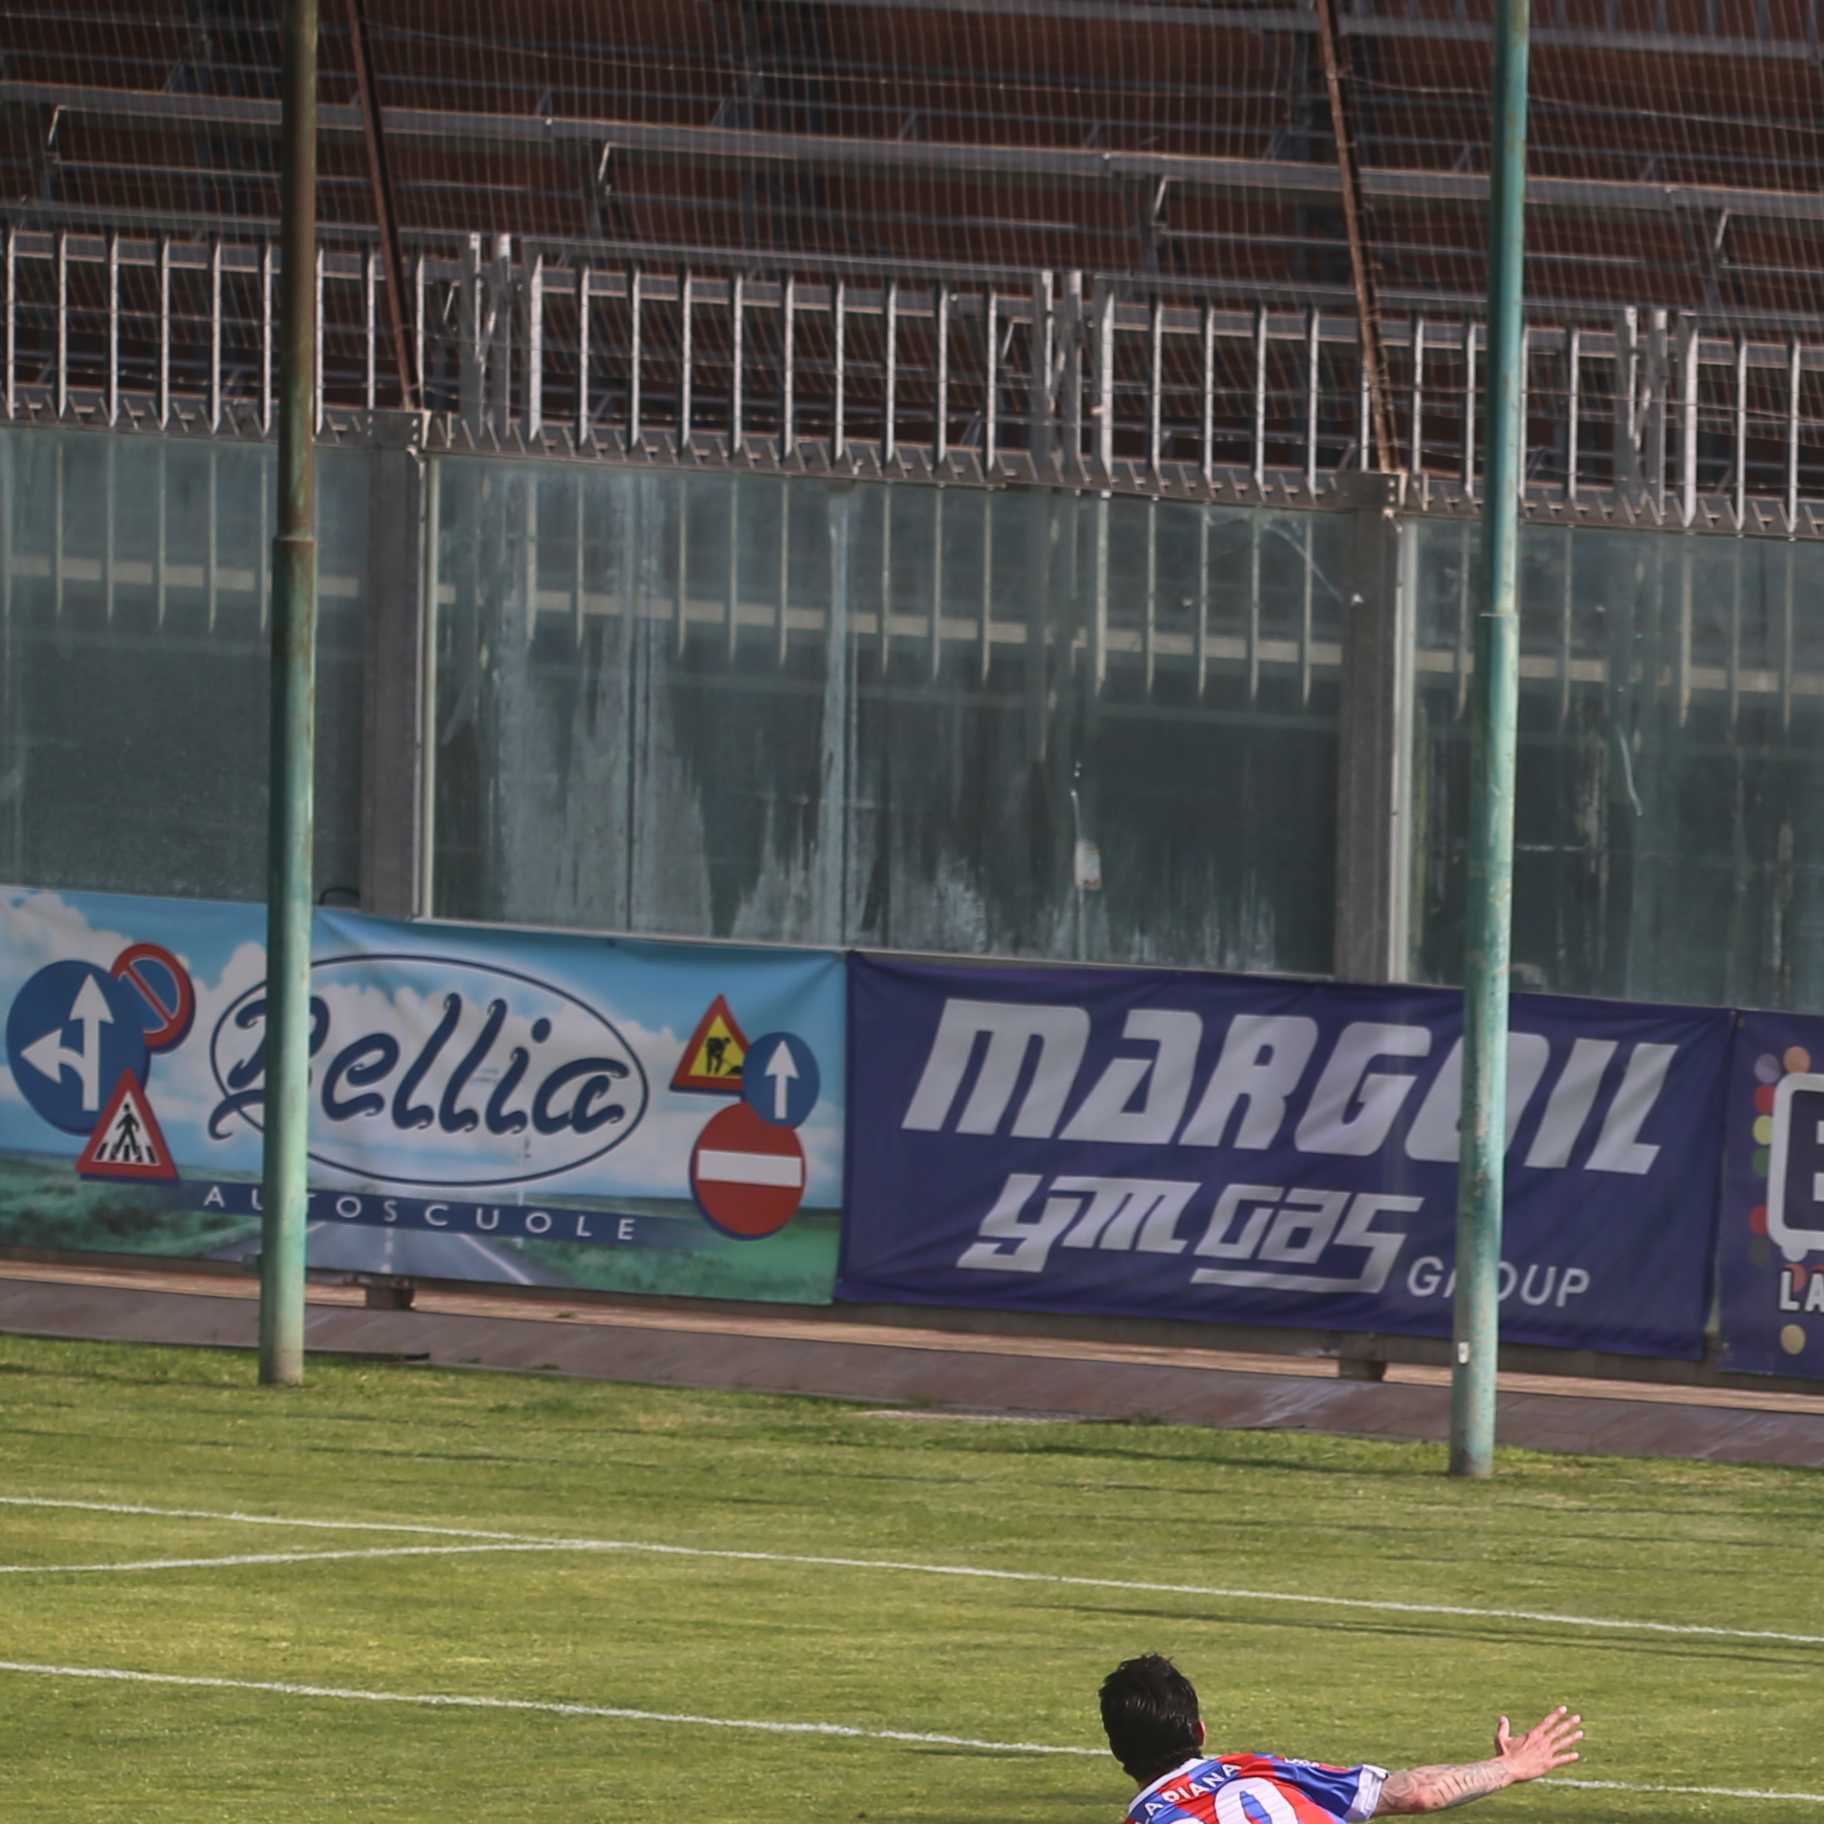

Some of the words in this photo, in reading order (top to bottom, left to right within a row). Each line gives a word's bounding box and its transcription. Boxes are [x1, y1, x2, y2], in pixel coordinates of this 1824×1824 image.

[204, 1186, 635, 1240] AOSCUOLE
[1407, 1256, 1590, 1307] GOUP
[1162, 1763, 1242, 1804] PIANA
